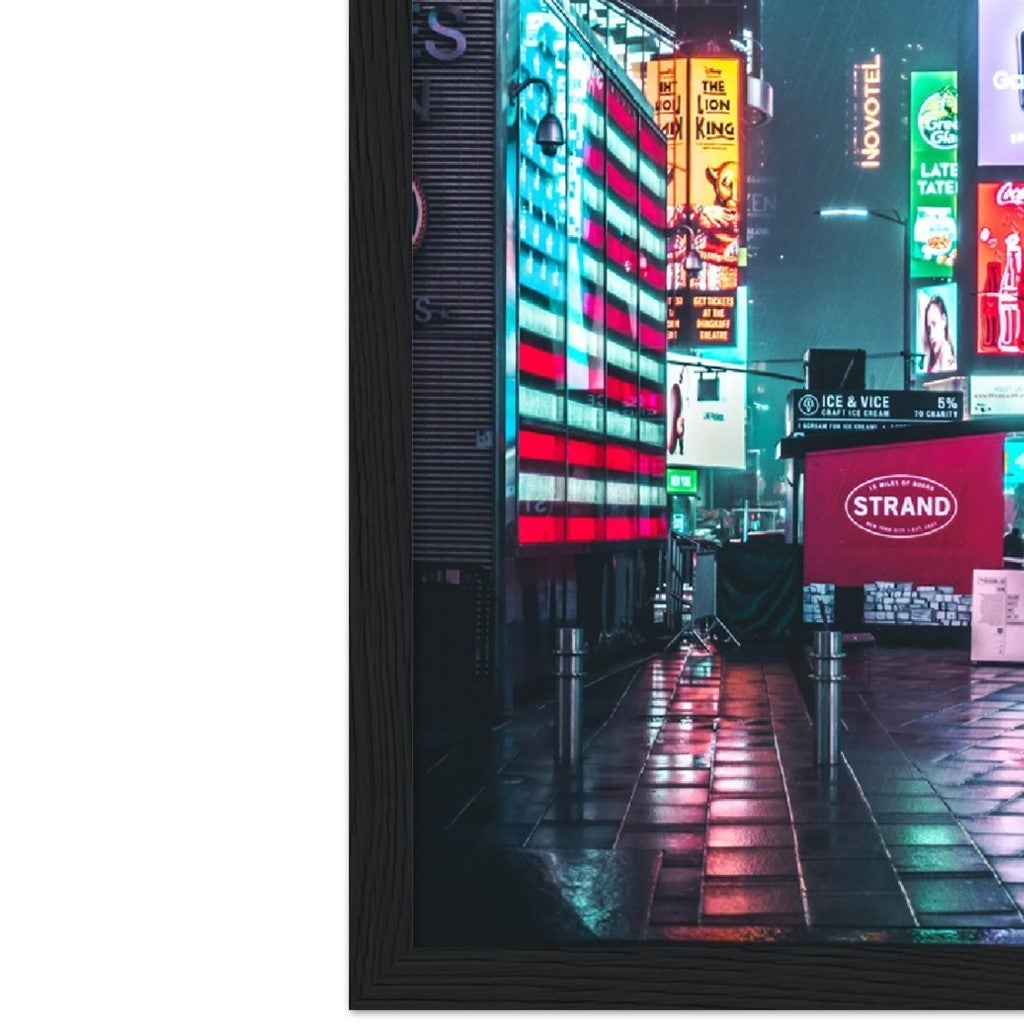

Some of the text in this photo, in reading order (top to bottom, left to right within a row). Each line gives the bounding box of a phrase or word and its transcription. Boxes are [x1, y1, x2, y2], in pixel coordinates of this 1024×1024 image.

[702, 80, 725, 92] THE
[697, 94, 730, 115] LION
[861, 54, 881, 168] NOVOTEL
[695, 116, 735, 140] KING
[917, 179, 958, 195] TATE
[822, 394, 890, 408] ICE & VICE
[937, 397, 958, 409] 5%
[820, 409, 846, 417] CRAFT
[848, 409, 861, 417] ICE
[914, 410, 958, 418] TO CHARITY
[879, 479, 899, 488] MILES
[912, 481, 935, 492] BOOKS
[853, 496, 951, 516] STRAND
